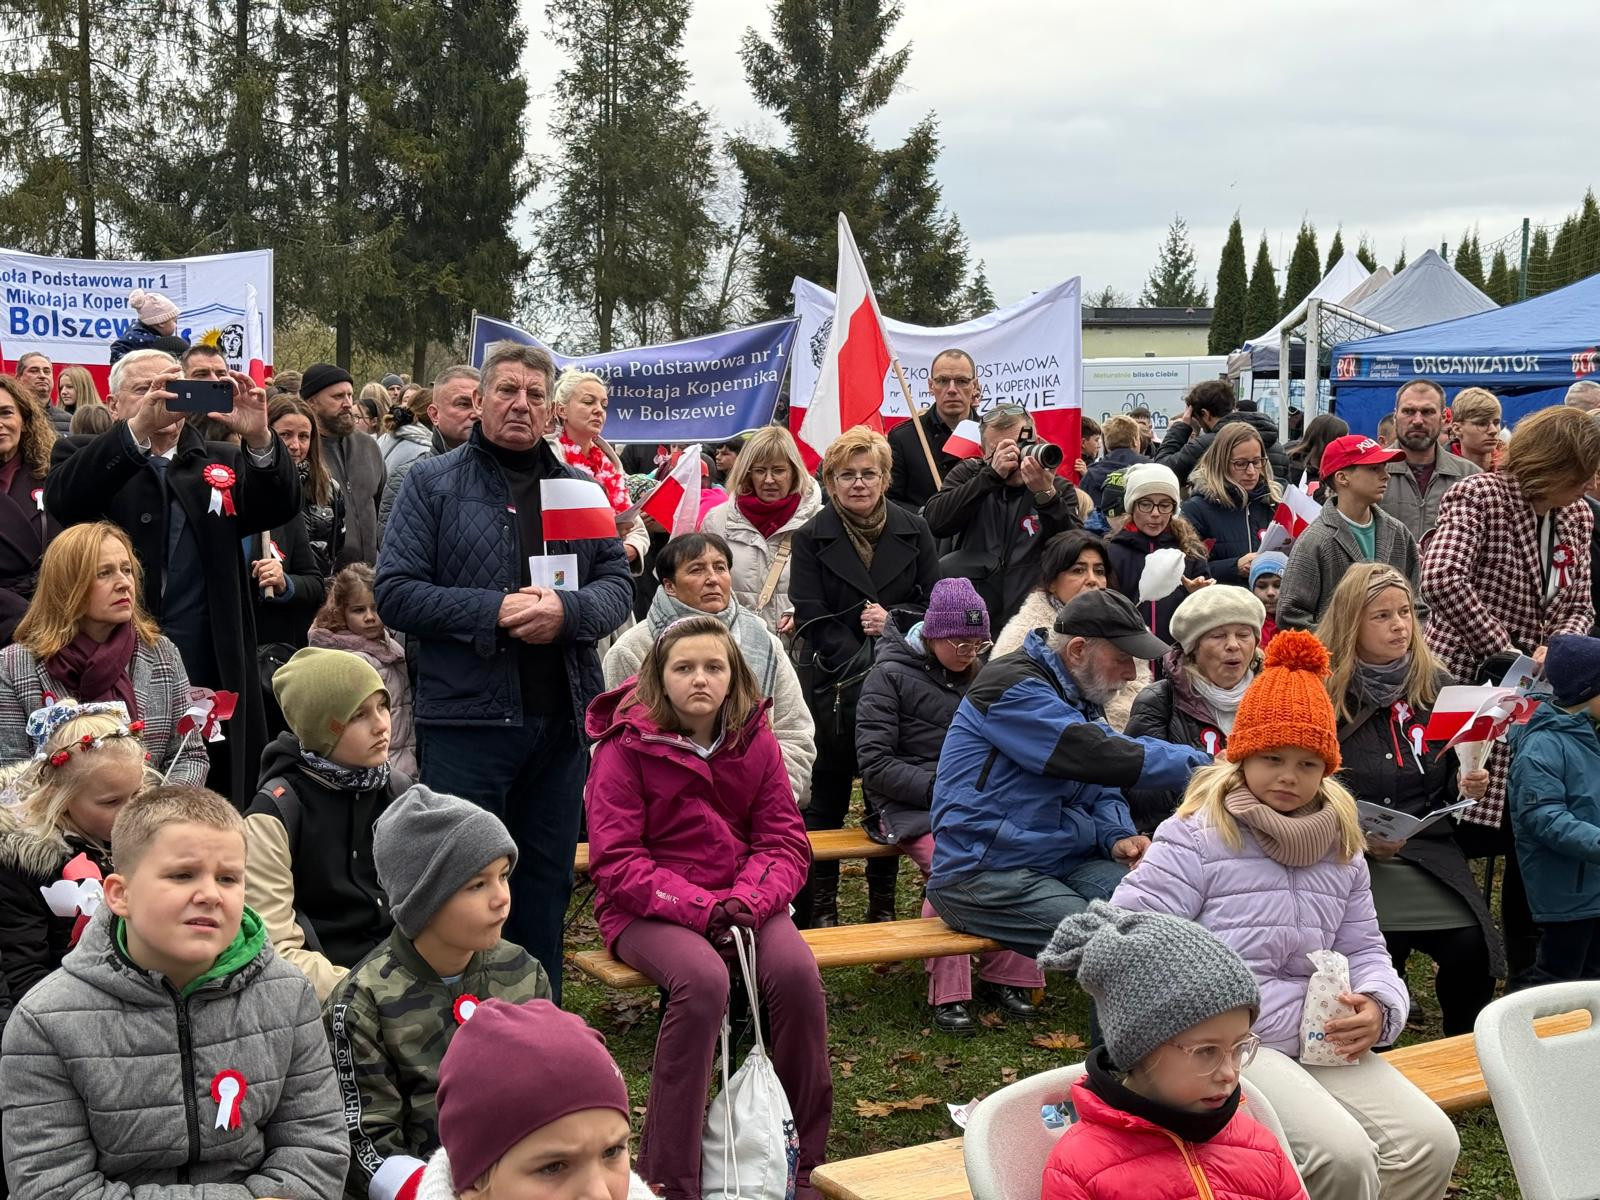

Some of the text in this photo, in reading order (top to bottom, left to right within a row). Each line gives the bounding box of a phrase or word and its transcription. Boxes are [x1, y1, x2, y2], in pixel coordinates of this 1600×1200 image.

[31, 270, 133, 288] Podstawowa
[138, 277, 155, 289] nr
[160, 274, 169, 289] 1
[6, 288, 129, 312] Mikołaja Koper
[9, 306, 137, 340] Bolszew
[629, 355, 746, 378] Podstawowa
[751, 349, 772, 364] nr
[775, 343, 785, 357] 1
[890, 355, 1059, 381] SZKO DSTAWOWA
[1337, 358, 1356, 376] BCK
[1412, 355, 1540, 374] ORGANIZATOR
[687, 368, 779, 396] Kopernika
[890, 390, 902, 398] nr
[995, 373, 1062, 393] KOPERNIKA
[1155, 370, 1179, 378] Ciebie
[617, 403, 736, 422] w Bolszewie
[1355, 437, 1382, 454] POL
[341, 1072, 358, 1110] HYPE
